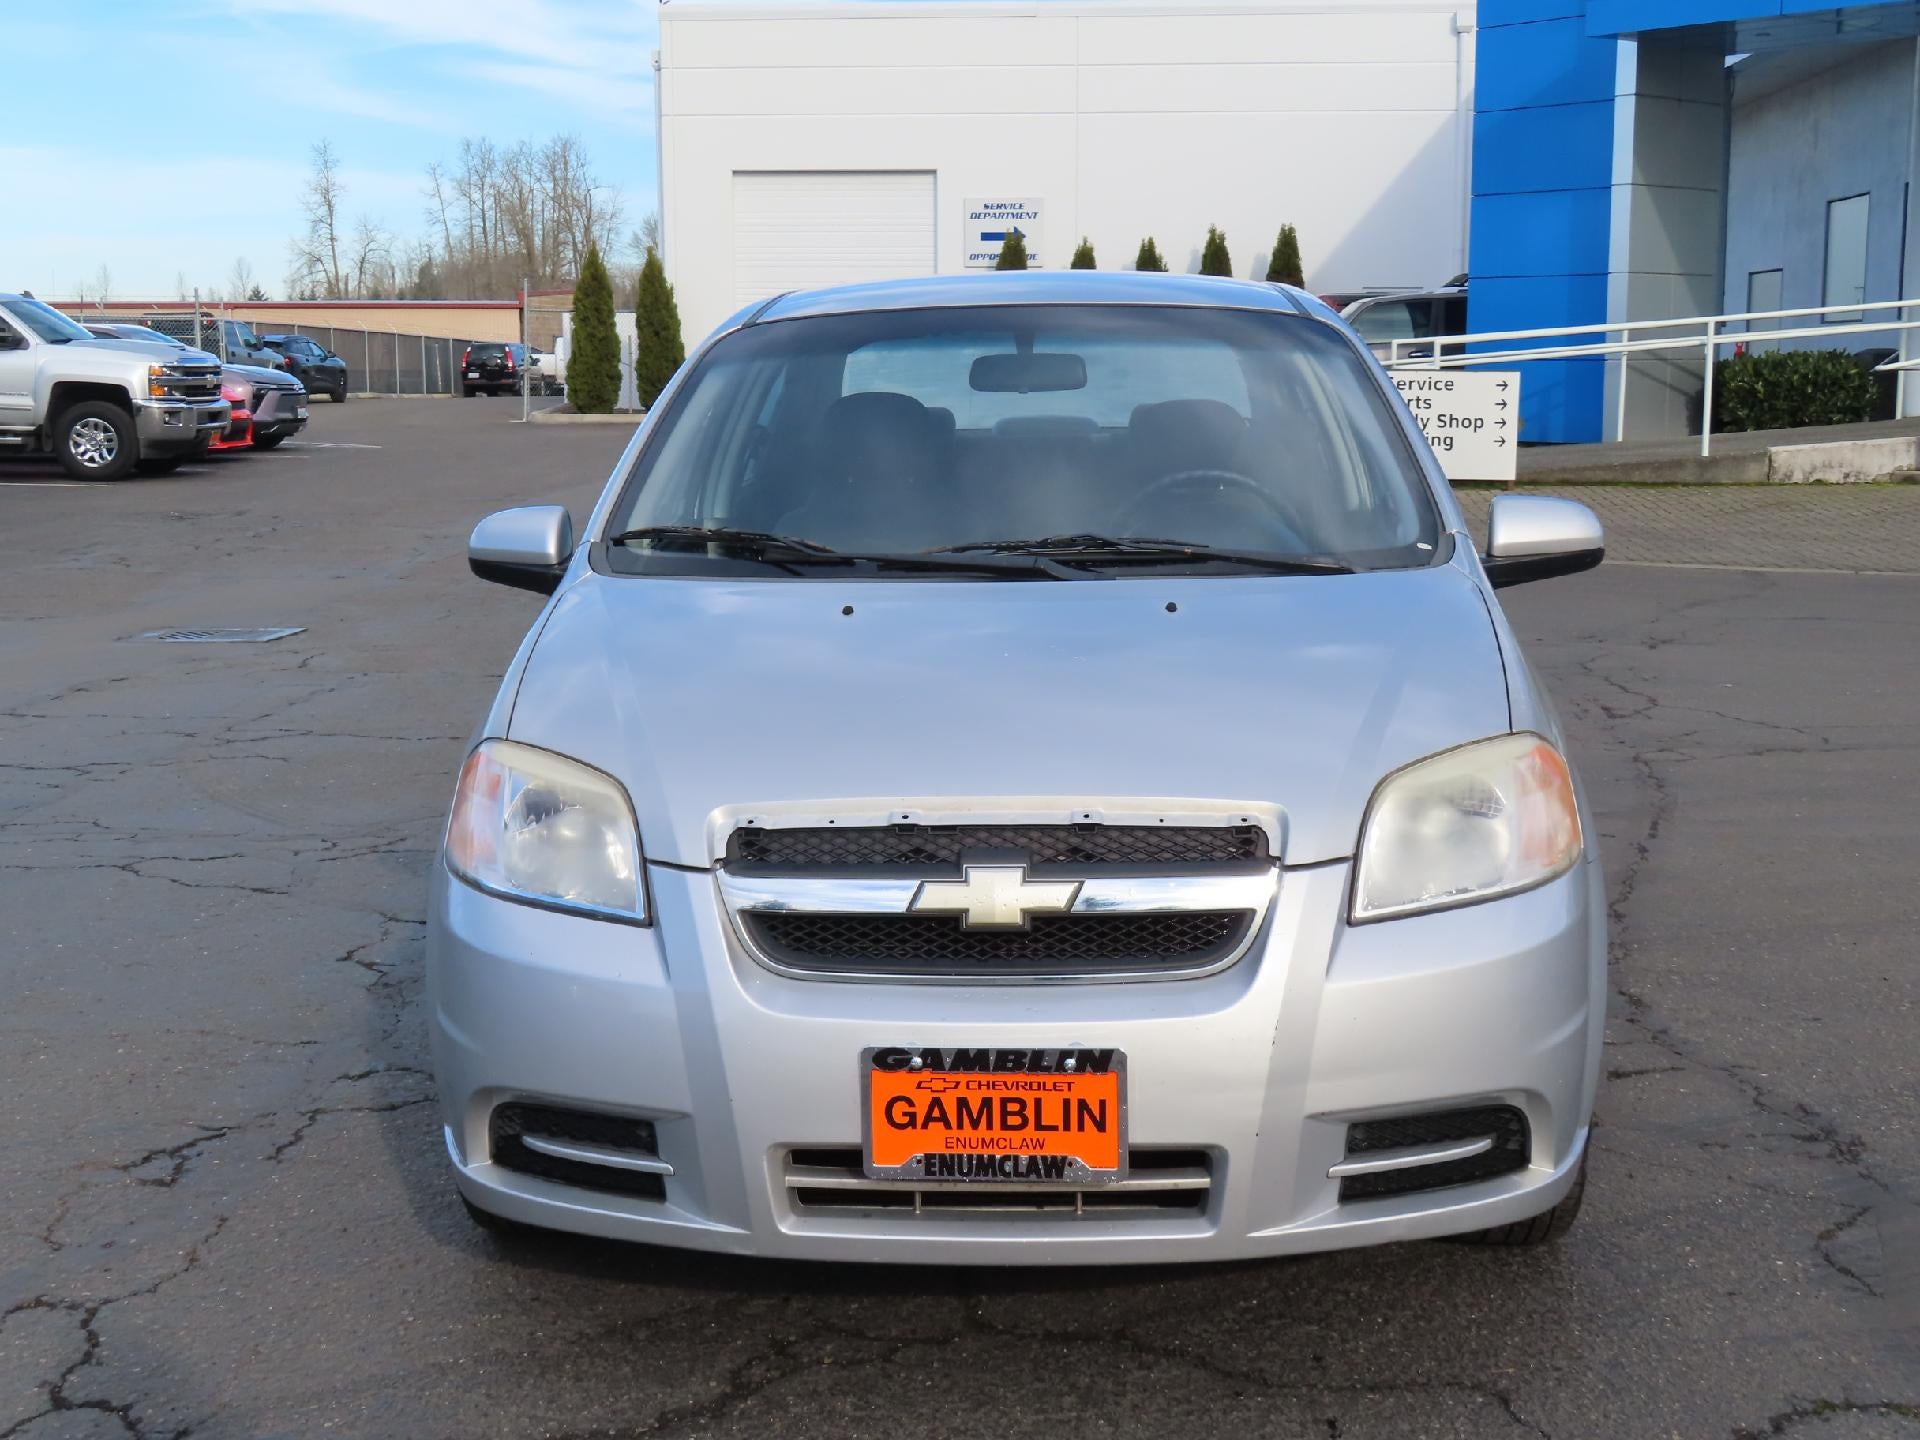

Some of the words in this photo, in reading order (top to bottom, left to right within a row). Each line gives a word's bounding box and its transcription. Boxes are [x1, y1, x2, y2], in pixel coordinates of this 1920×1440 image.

[1390, 377, 1454, 391] ervice
[1407, 396, 1432, 409] rts
[1437, 414, 1484, 433] Shop
[872, 1048, 1116, 1073] GAMBLIN
[965, 1080, 1076, 1092] CHEVROLET
[884, 1096, 1107, 1133] GAMBLIN
[945, 1137, 1046, 1150] ENUMCLAW
[924, 1154, 1067, 1179] ENUMCLAW
